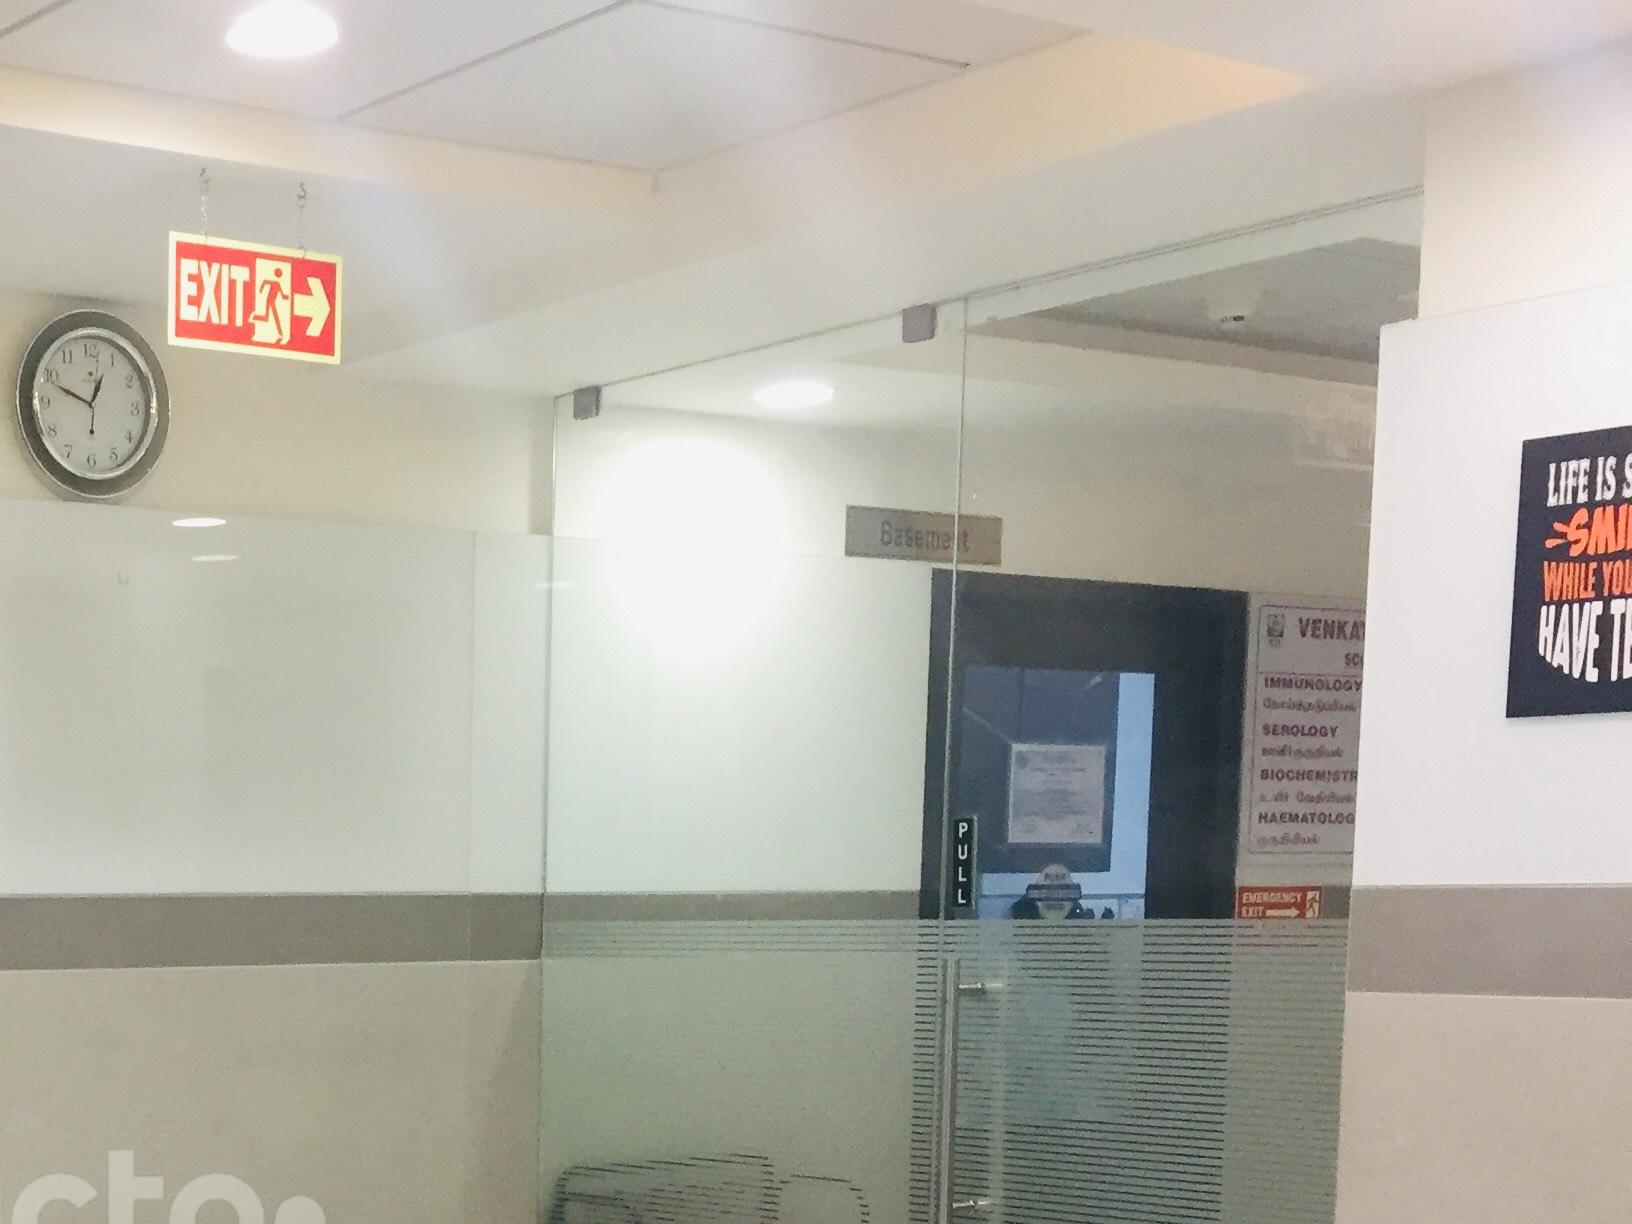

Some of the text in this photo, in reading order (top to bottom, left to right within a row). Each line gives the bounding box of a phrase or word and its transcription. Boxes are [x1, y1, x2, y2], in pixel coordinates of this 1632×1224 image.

[180, 257, 250, 327] EXIT
[62, 349, 72, 364] 11
[83, 343, 98, 358] 12
[125, 374, 134, 390] 2
[41, 395, 51, 410] 9
[48, 424, 58, 438] 8
[124, 430, 132, 443] 4
[63, 444, 72, 459] 7
[109, 447, 119, 461] 5
[87, 453, 97, 467] 6
[1546, 458, 1591, 507] LIFE
[1595, 455, 1617, 501] IS
[1543, 560, 1597, 601] WHILE
[1538, 600, 1604, 683] HAVE
[1264, 677, 1363, 691] IMMUNOLOGY
[1262, 723, 1339, 738] SEROLOGY
[957, 822, 969, 904] PULL
[1242, 891, 1303, 904] EMERGENCY
